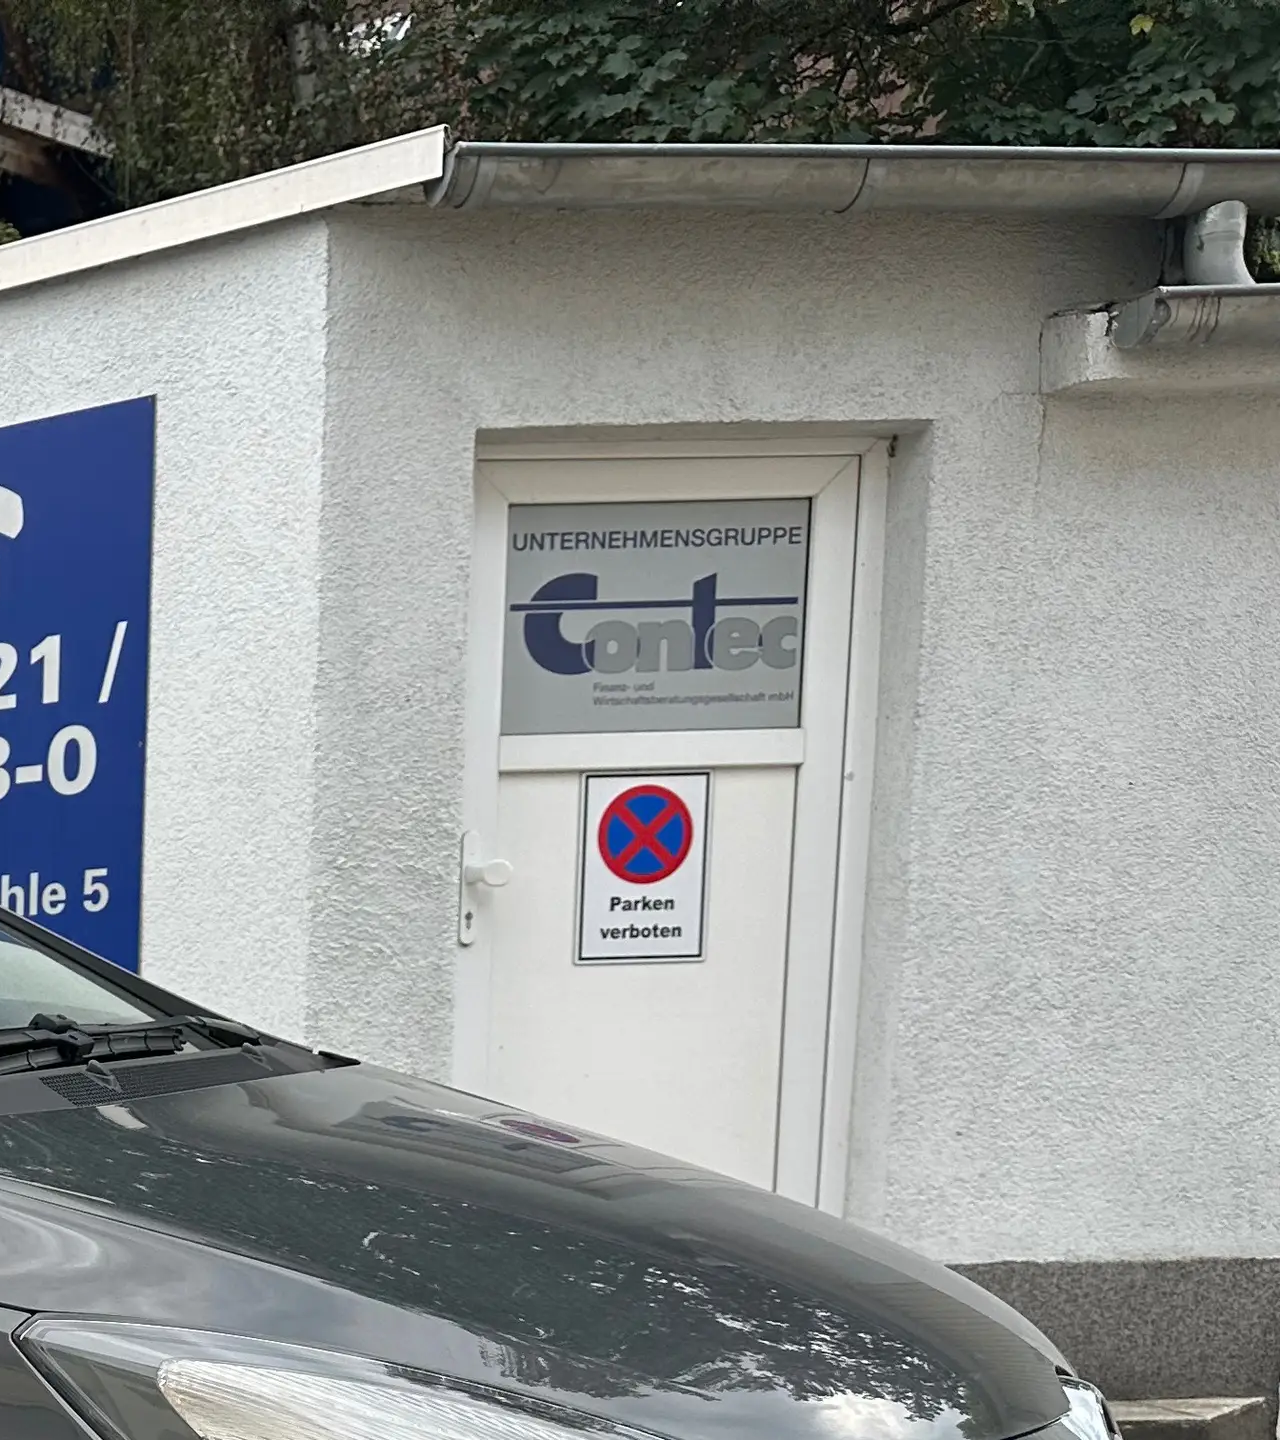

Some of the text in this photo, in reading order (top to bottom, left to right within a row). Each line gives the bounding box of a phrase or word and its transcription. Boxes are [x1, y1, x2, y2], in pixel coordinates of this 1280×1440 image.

[512, 527, 802, 551] UNTERNEHMENSGRUPPE
[510, 572, 798, 675] Contec
[98, 620, 128, 704] /
[633, 681, 655, 692] und
[83, 867, 109, 913] 5
[609, 896, 675, 912] Parken
[600, 923, 682, 939] verboten
